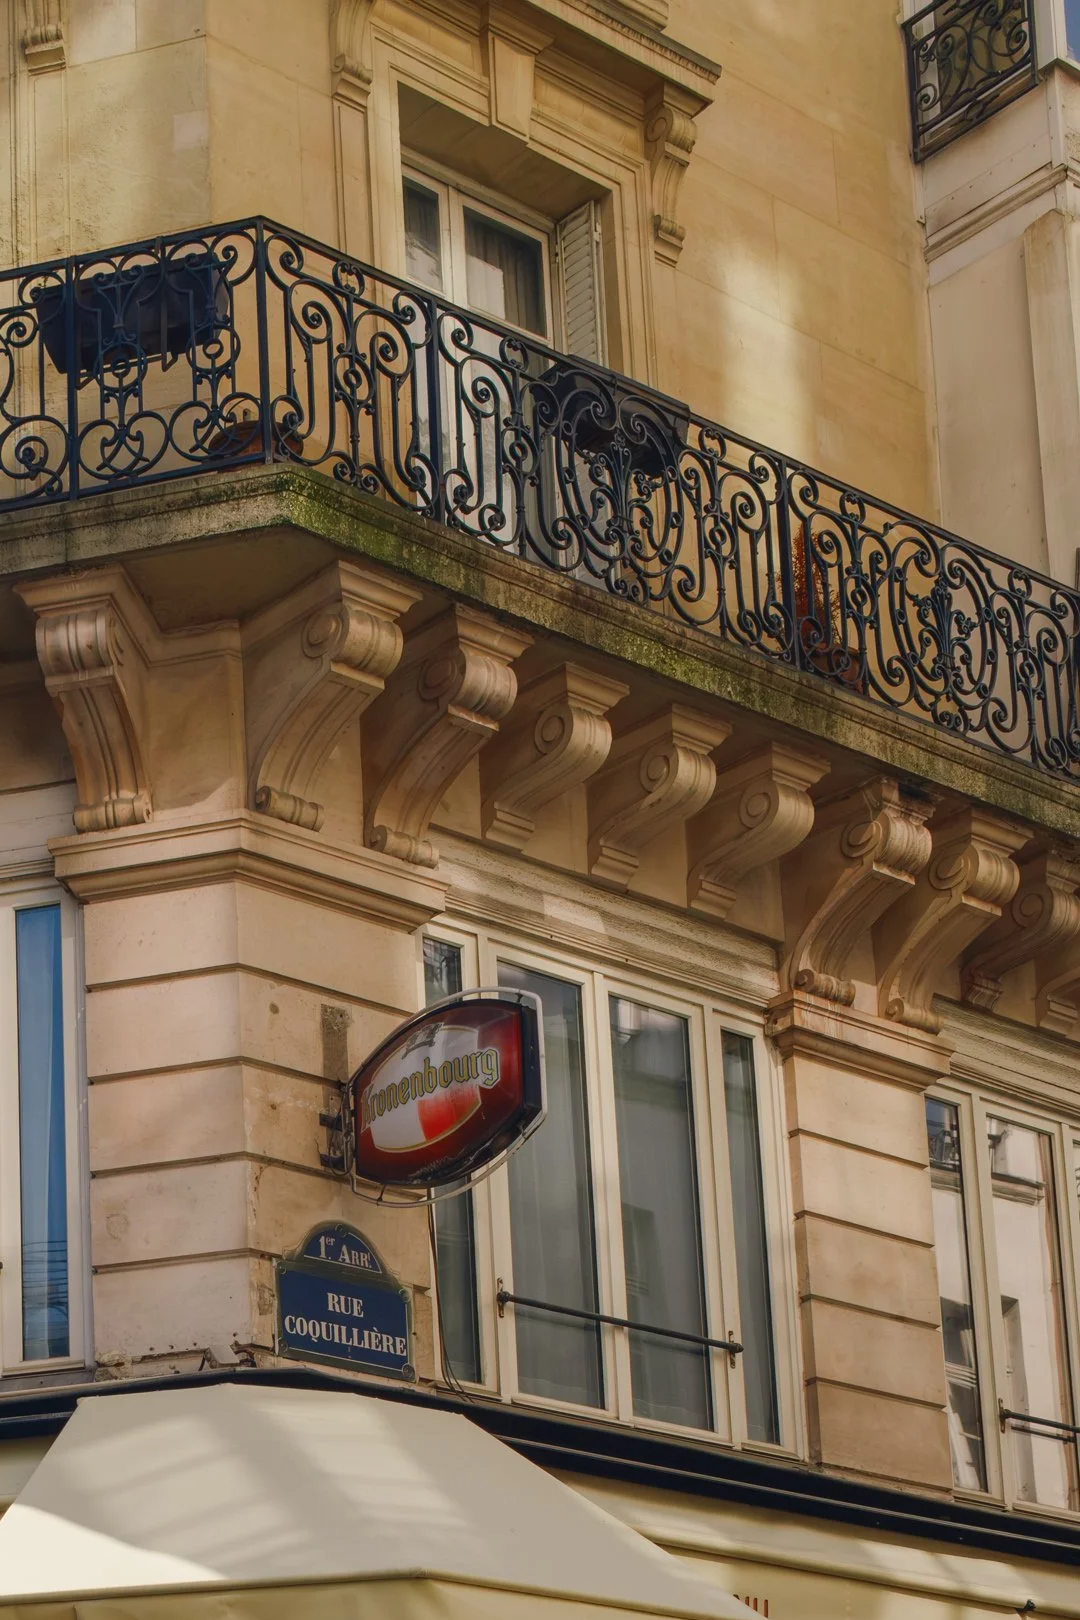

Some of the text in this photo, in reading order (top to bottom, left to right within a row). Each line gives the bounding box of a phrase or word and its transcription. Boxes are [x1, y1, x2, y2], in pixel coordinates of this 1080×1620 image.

[361, 1048, 500, 1132] Kronenbourg
[327, 1292, 364, 1318] RUE
[284, 1315, 407, 1357] COQUILLIÈRE
